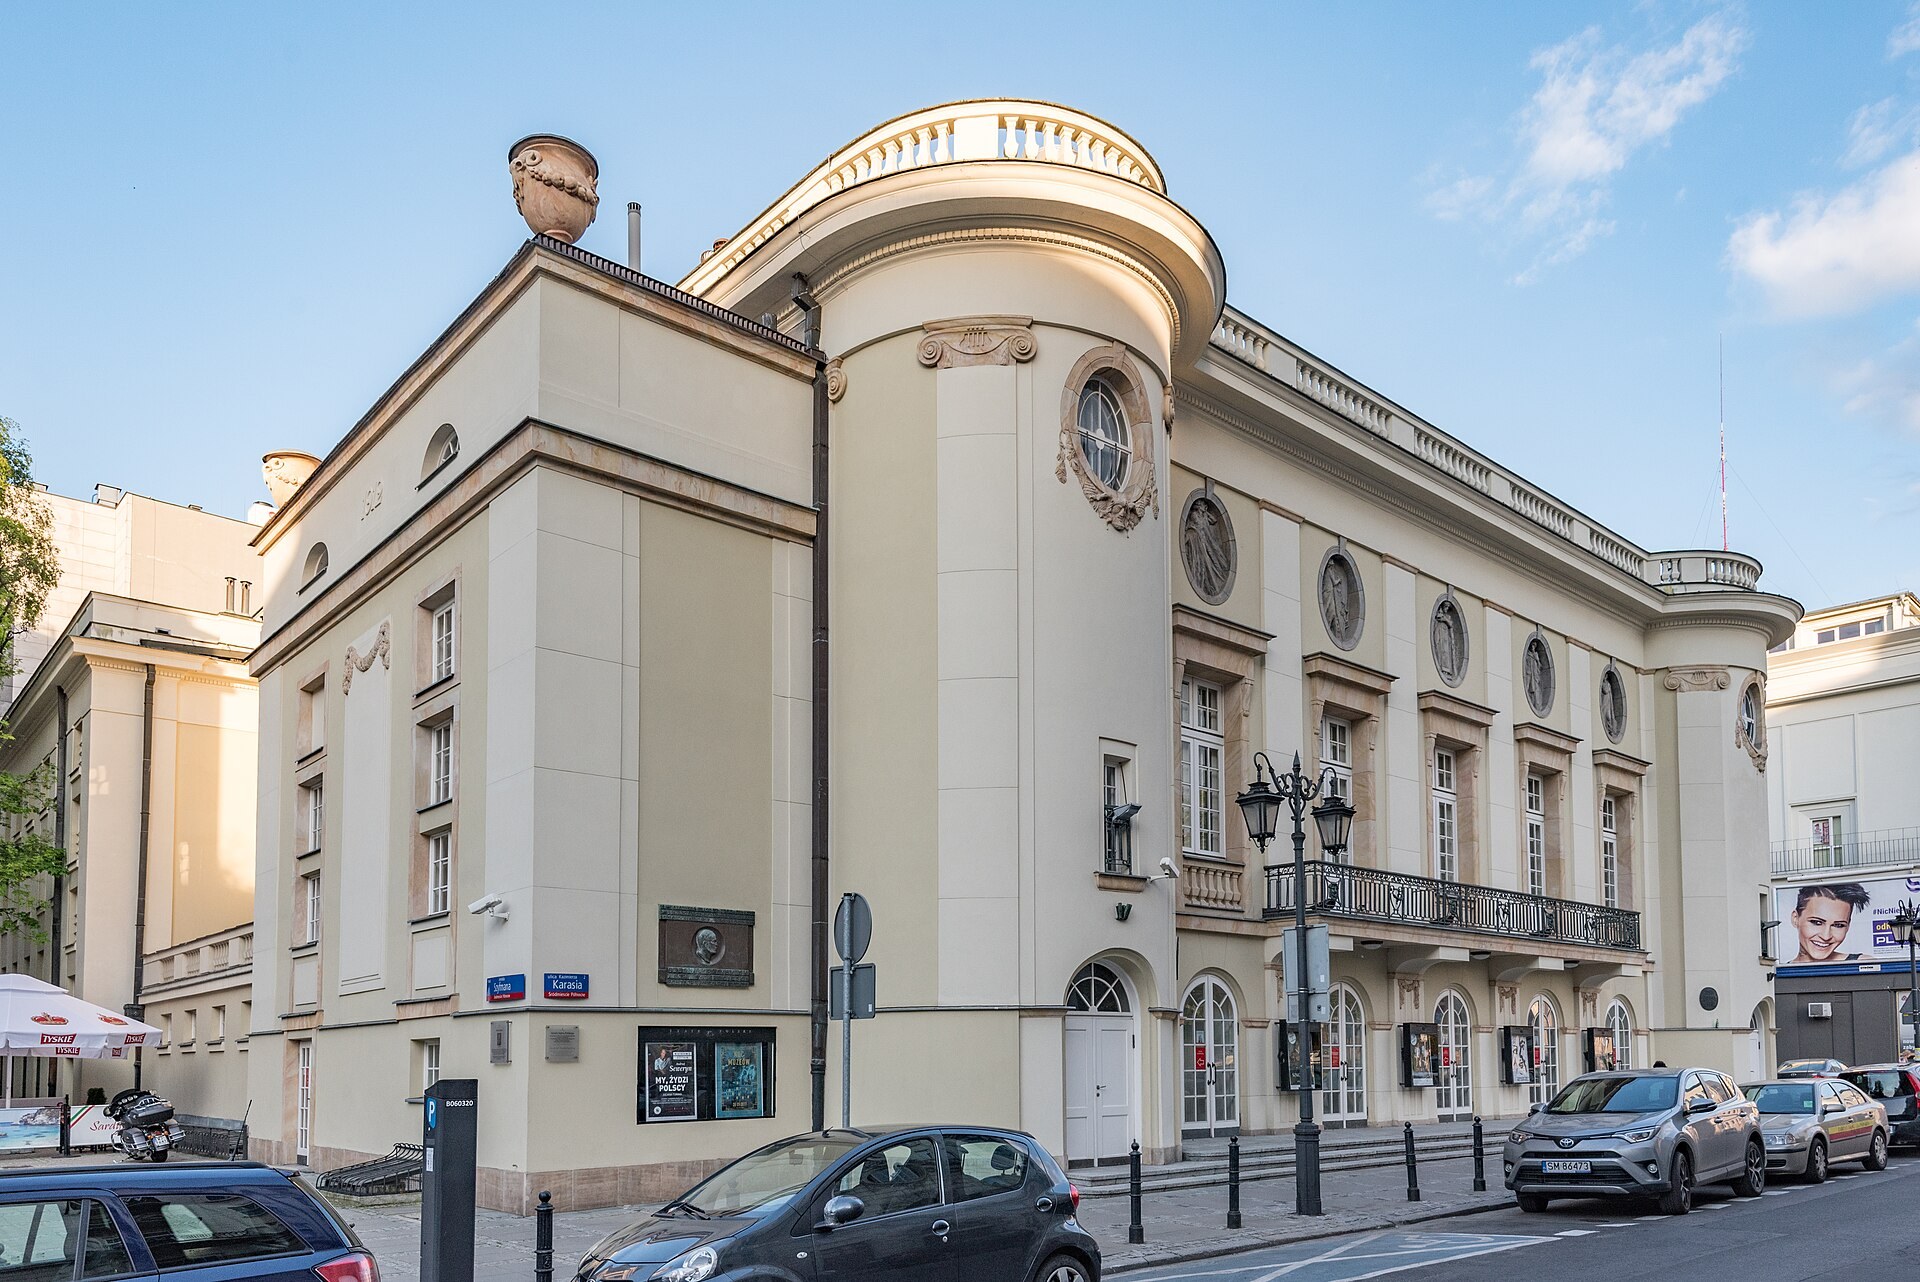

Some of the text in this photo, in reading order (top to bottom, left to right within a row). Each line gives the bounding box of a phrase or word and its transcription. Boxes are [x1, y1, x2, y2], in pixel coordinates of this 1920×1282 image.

[552, 979, 583, 990] Karasia
[43, 1035, 74, 1044] TYSKIE
[126, 1034, 145, 1043] TYSKIE
[655, 1074, 689, 1085] MY, ŻYDZI
[659, 1084, 686, 1092] POLSCY
[429, 1101, 435, 1122] P
[1547, 1162, 1589, 1170] SM 86473
